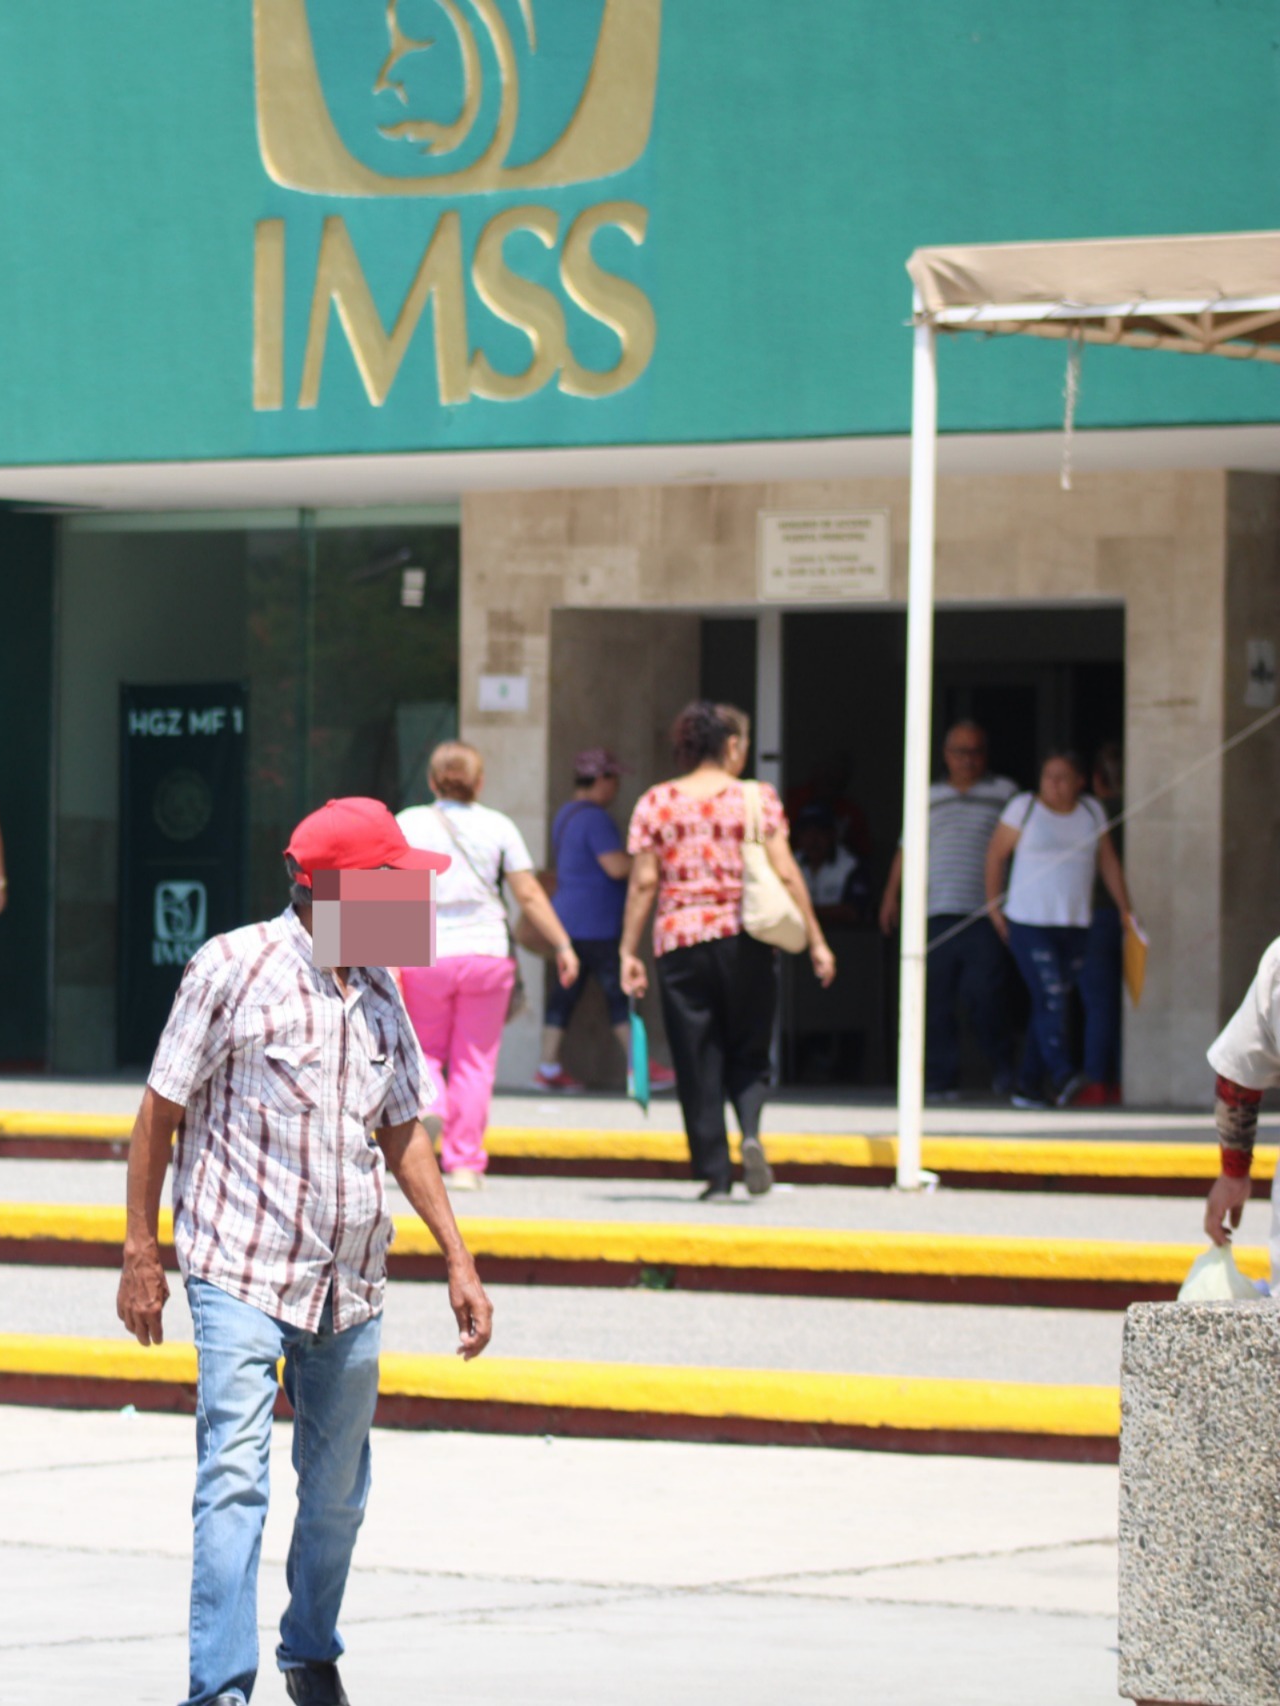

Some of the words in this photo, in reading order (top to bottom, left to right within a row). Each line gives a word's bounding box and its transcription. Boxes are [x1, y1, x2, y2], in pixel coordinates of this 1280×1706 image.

[252, 199, 657, 412] IMSS
[128, 707, 183, 736] HGZ
[187, 706, 227, 736] MF
[232, 705, 244, 735] 1
[152, 940, 204, 966] IMS
